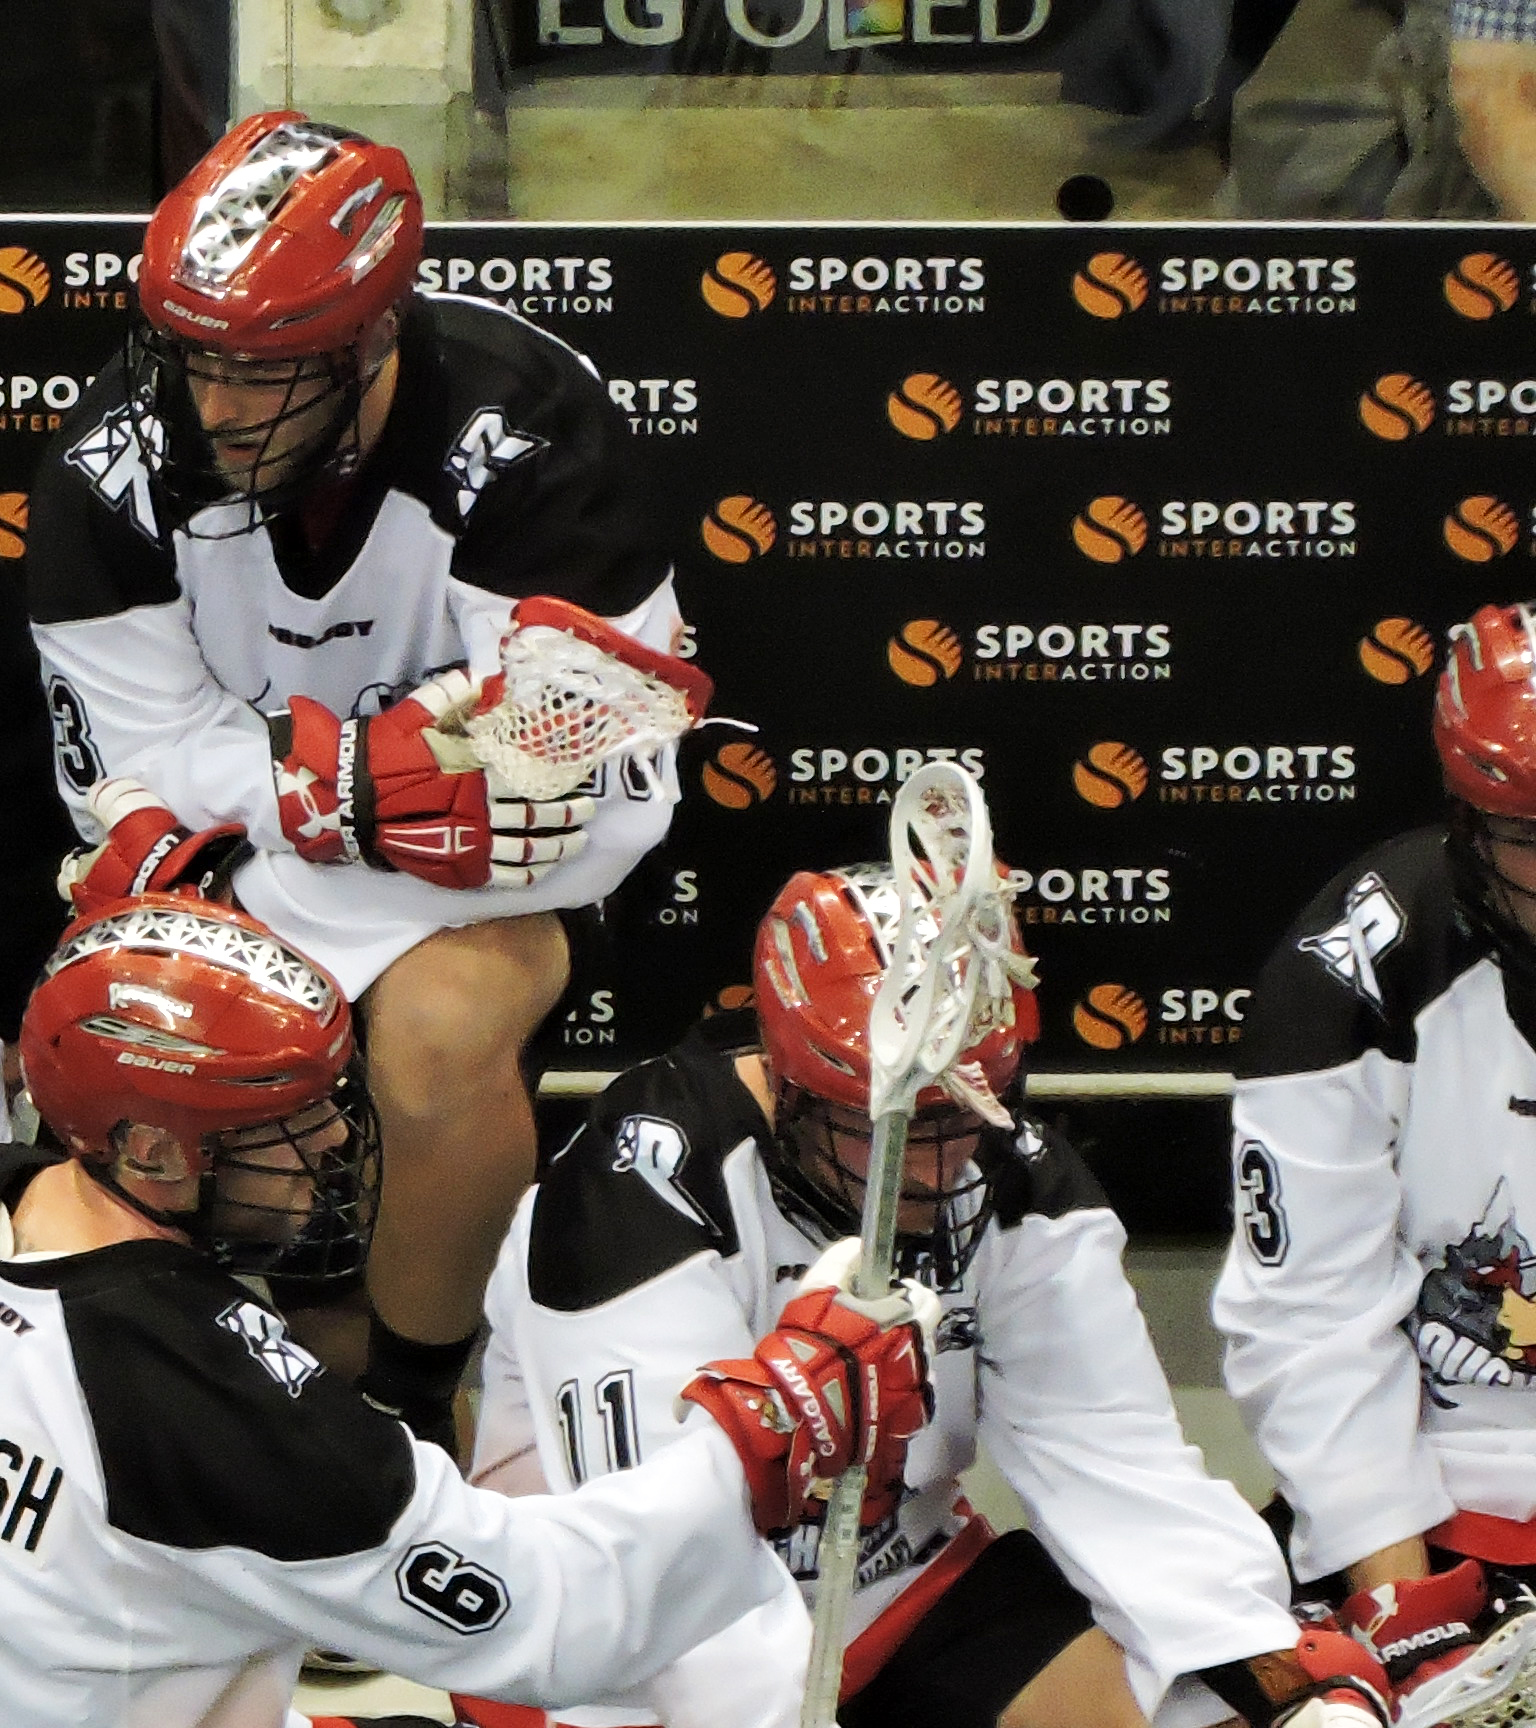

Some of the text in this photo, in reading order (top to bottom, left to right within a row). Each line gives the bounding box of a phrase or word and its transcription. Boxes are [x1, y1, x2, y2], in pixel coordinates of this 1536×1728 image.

[789, 257, 984, 293] SPORTS
[1161, 258, 1356, 294] SPORTS
[789, 296, 984, 313] INTERACTION
[1161, 297, 1356, 314] INTERACTION
[975, 379, 1171, 415] SPORTS
[975, 418, 1171, 435] INTERACTION
[790, 501, 985, 537] SPORTS
[1161, 501, 1356, 537] SPORTS
[790, 540, 985, 559] INTERACTION
[1161, 540, 1356, 558] INTERACTION
[975, 624, 1170, 660] SPORTS
[975, 663, 1170, 681] INTERACTION
[1161, 745, 1355, 781] SPORTS
[1161, 784, 1355, 802] INTERACTION
[1007, 869, 1171, 903] PORTS
[116, 1052, 196, 1077] BAUER
[554, 1368, 642, 1490] 11
[397, 1540, 511, 1635] 6
